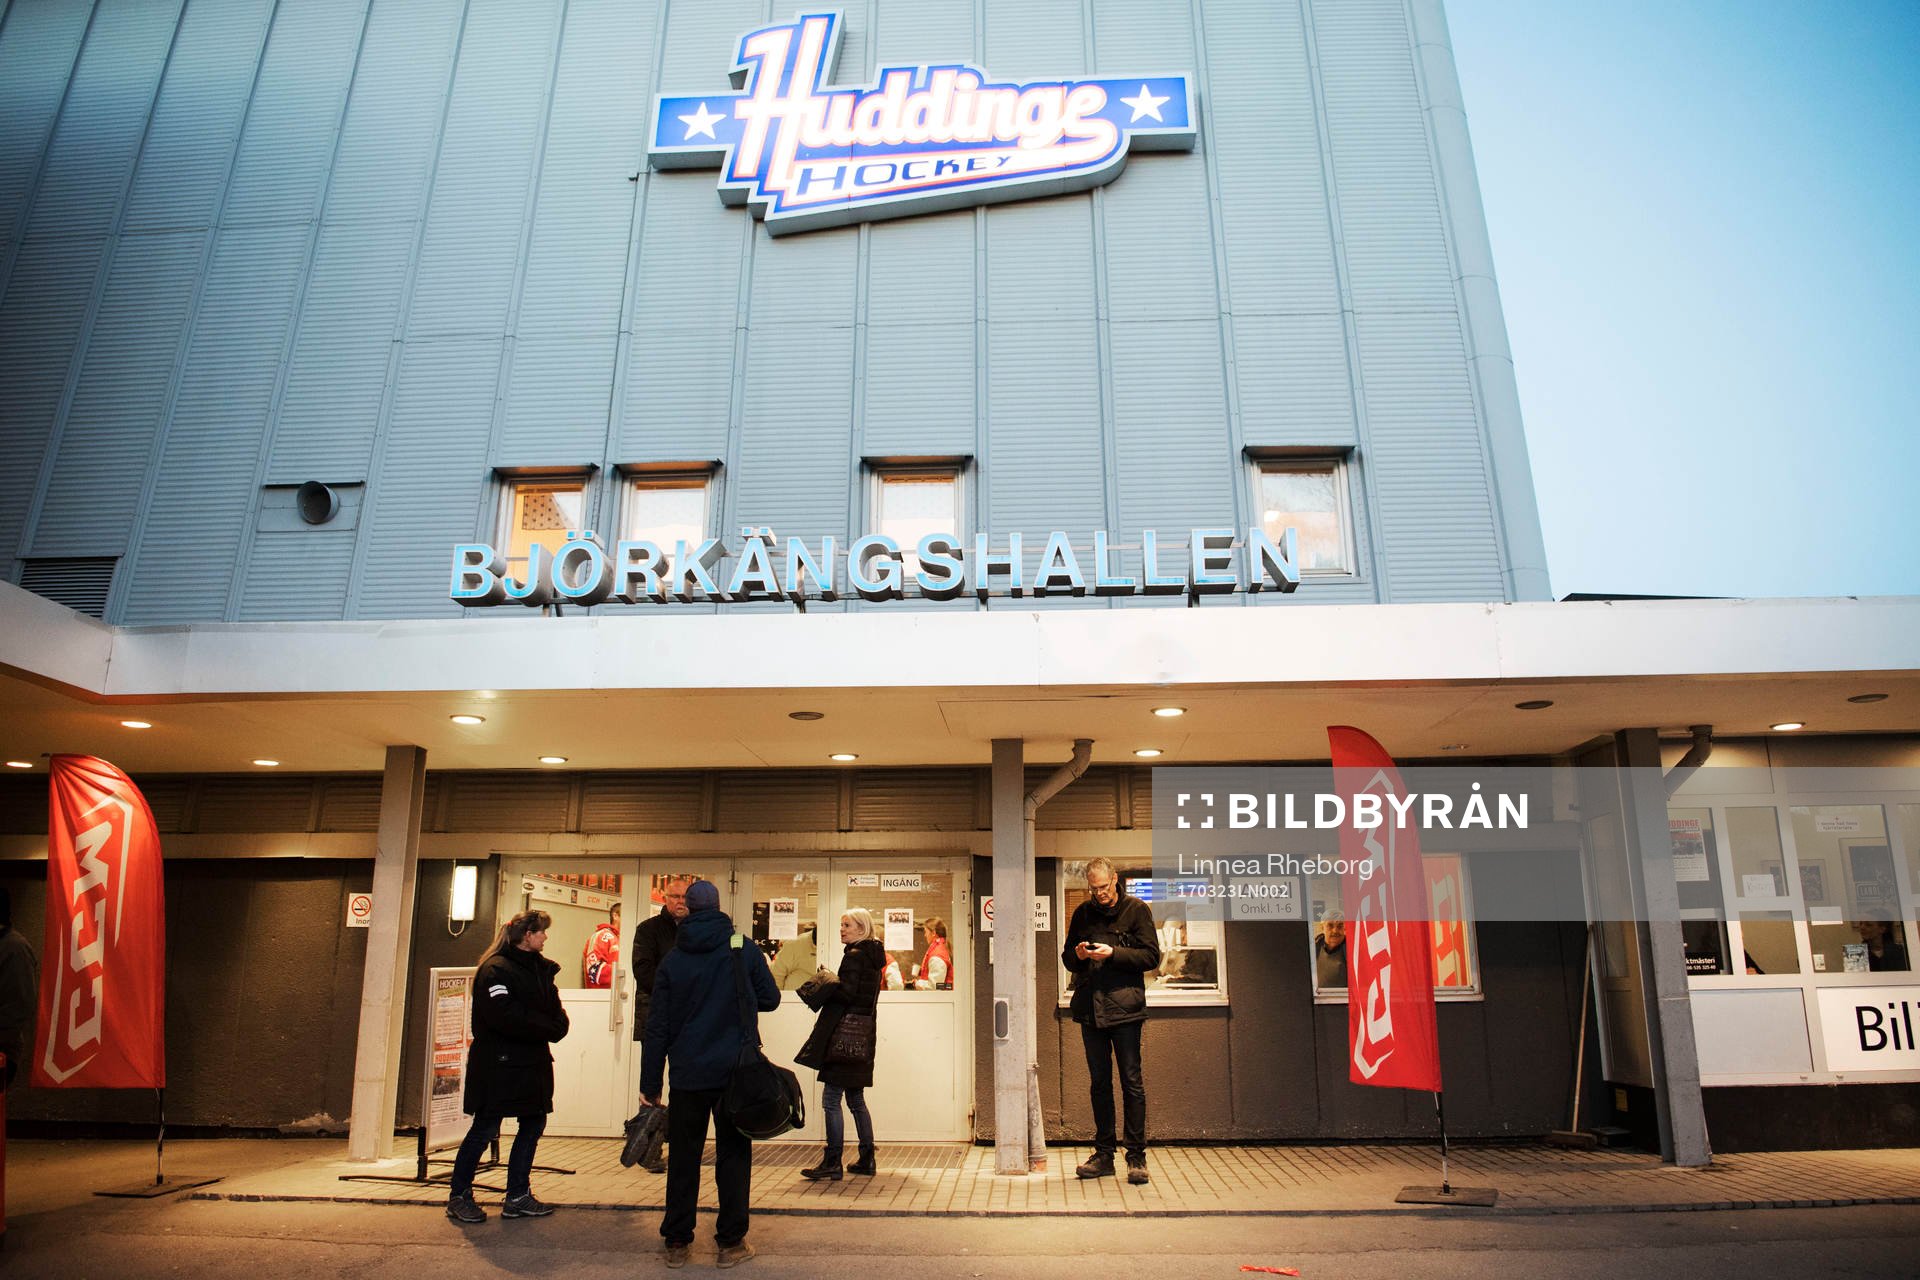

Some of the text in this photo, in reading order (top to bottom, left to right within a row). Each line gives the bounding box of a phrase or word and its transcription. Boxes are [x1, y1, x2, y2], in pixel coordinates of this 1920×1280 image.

[733, 17, 1117, 192] Huddinge
[797, 156, 1012, 196] HOCKEY
[451, 527, 1301, 602] BJÖRKÄNGSHALLEN
[883, 876, 920, 887] INGÅNG
[1241, 903, 1292, 914] Omkl. 1-6
